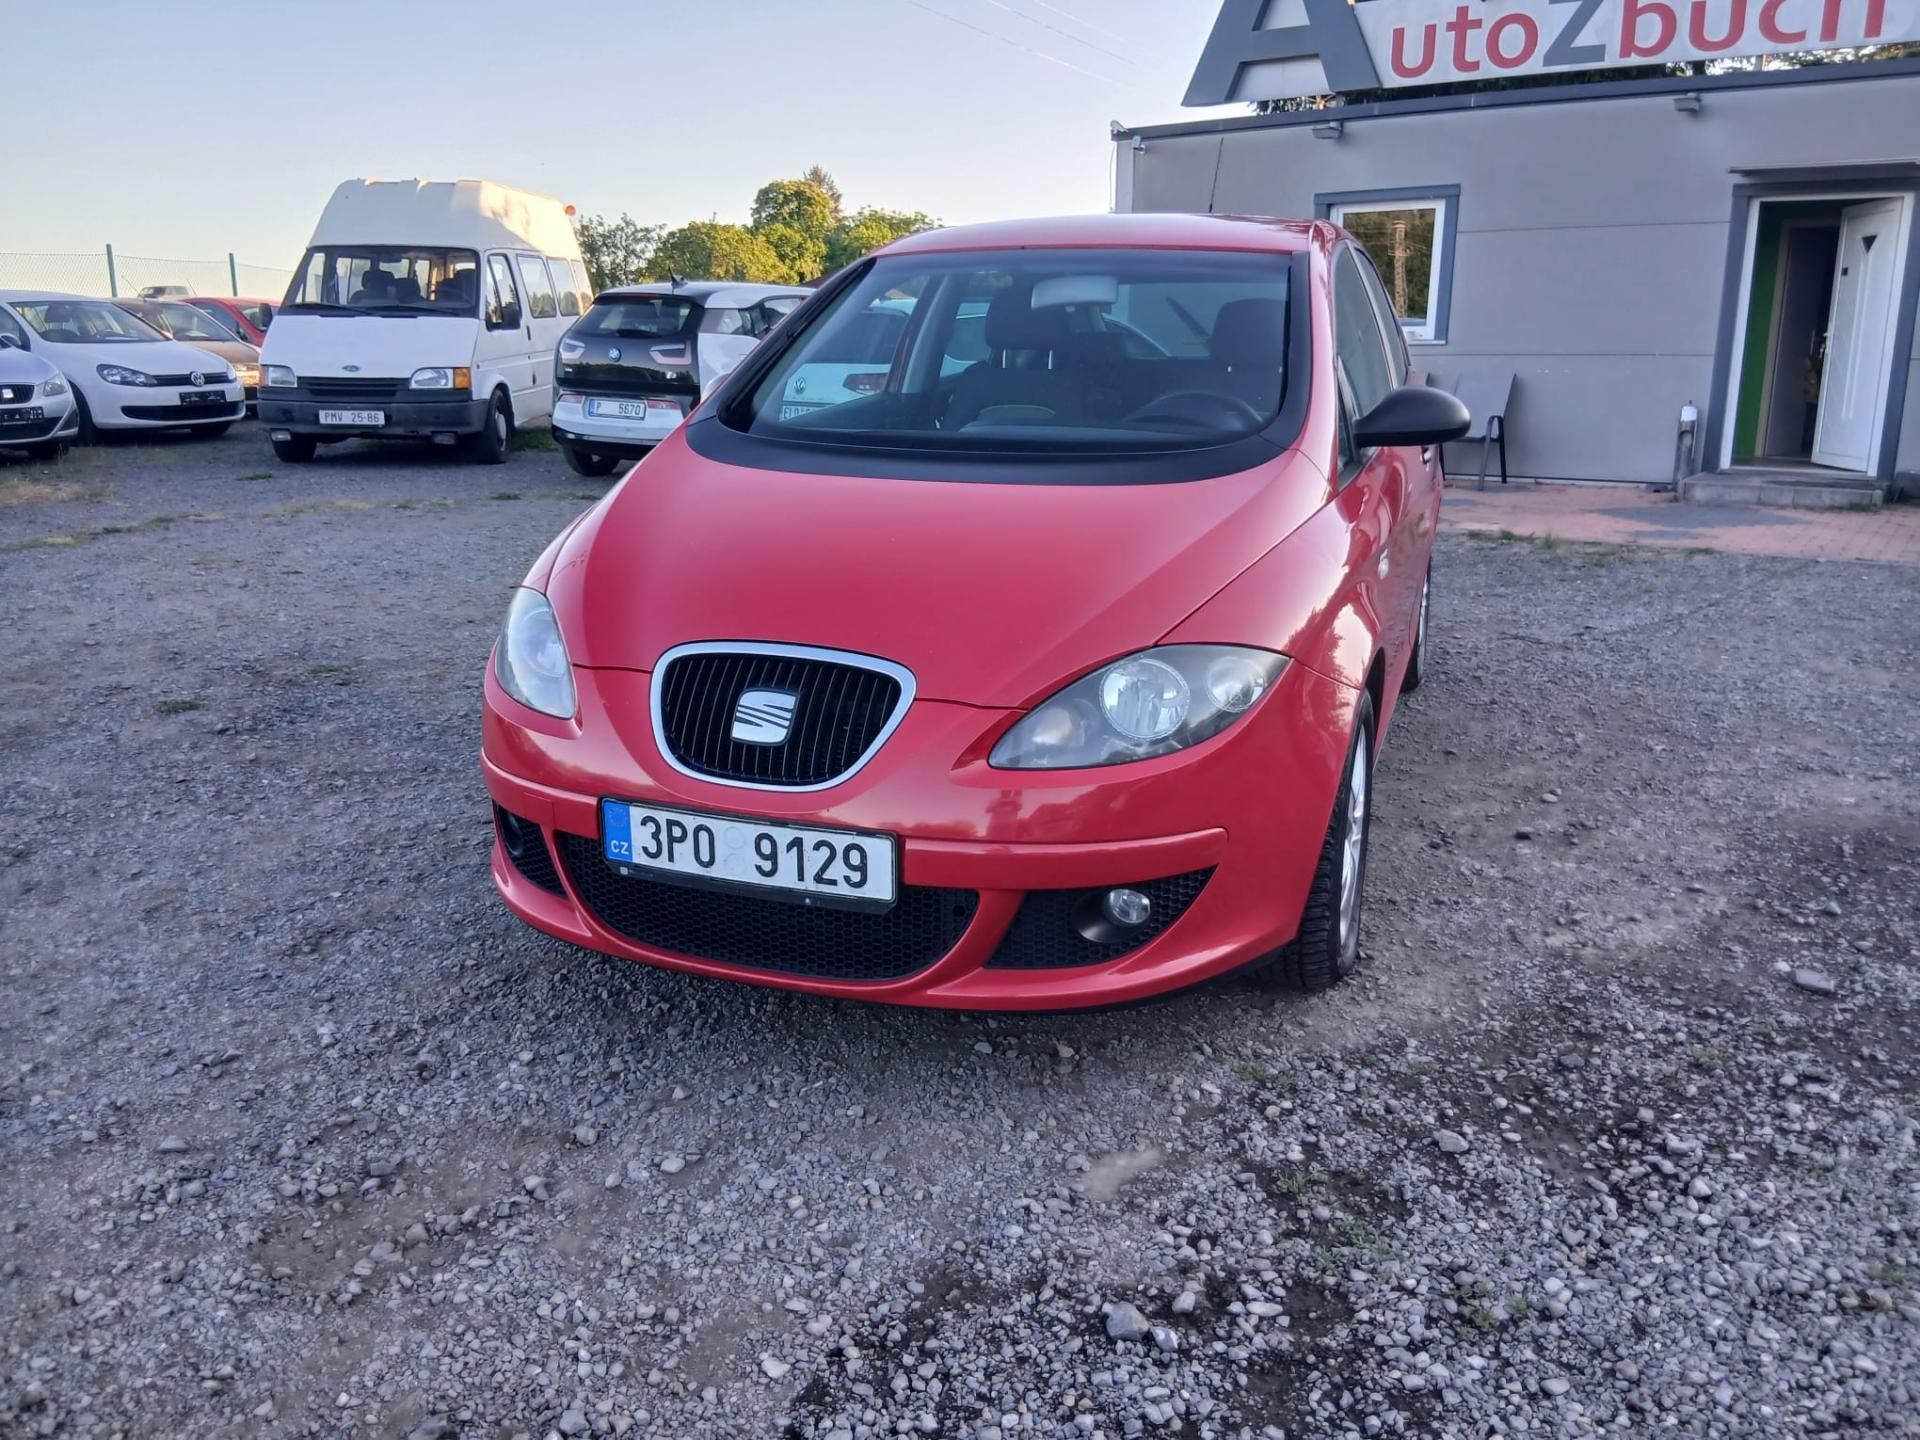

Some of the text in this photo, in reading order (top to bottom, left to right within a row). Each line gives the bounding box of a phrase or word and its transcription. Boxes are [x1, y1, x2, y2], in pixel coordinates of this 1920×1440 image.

[324, 411, 343, 422] PMV
[610, 839, 629, 855] CZ
[754, 832, 868, 889] 9129
